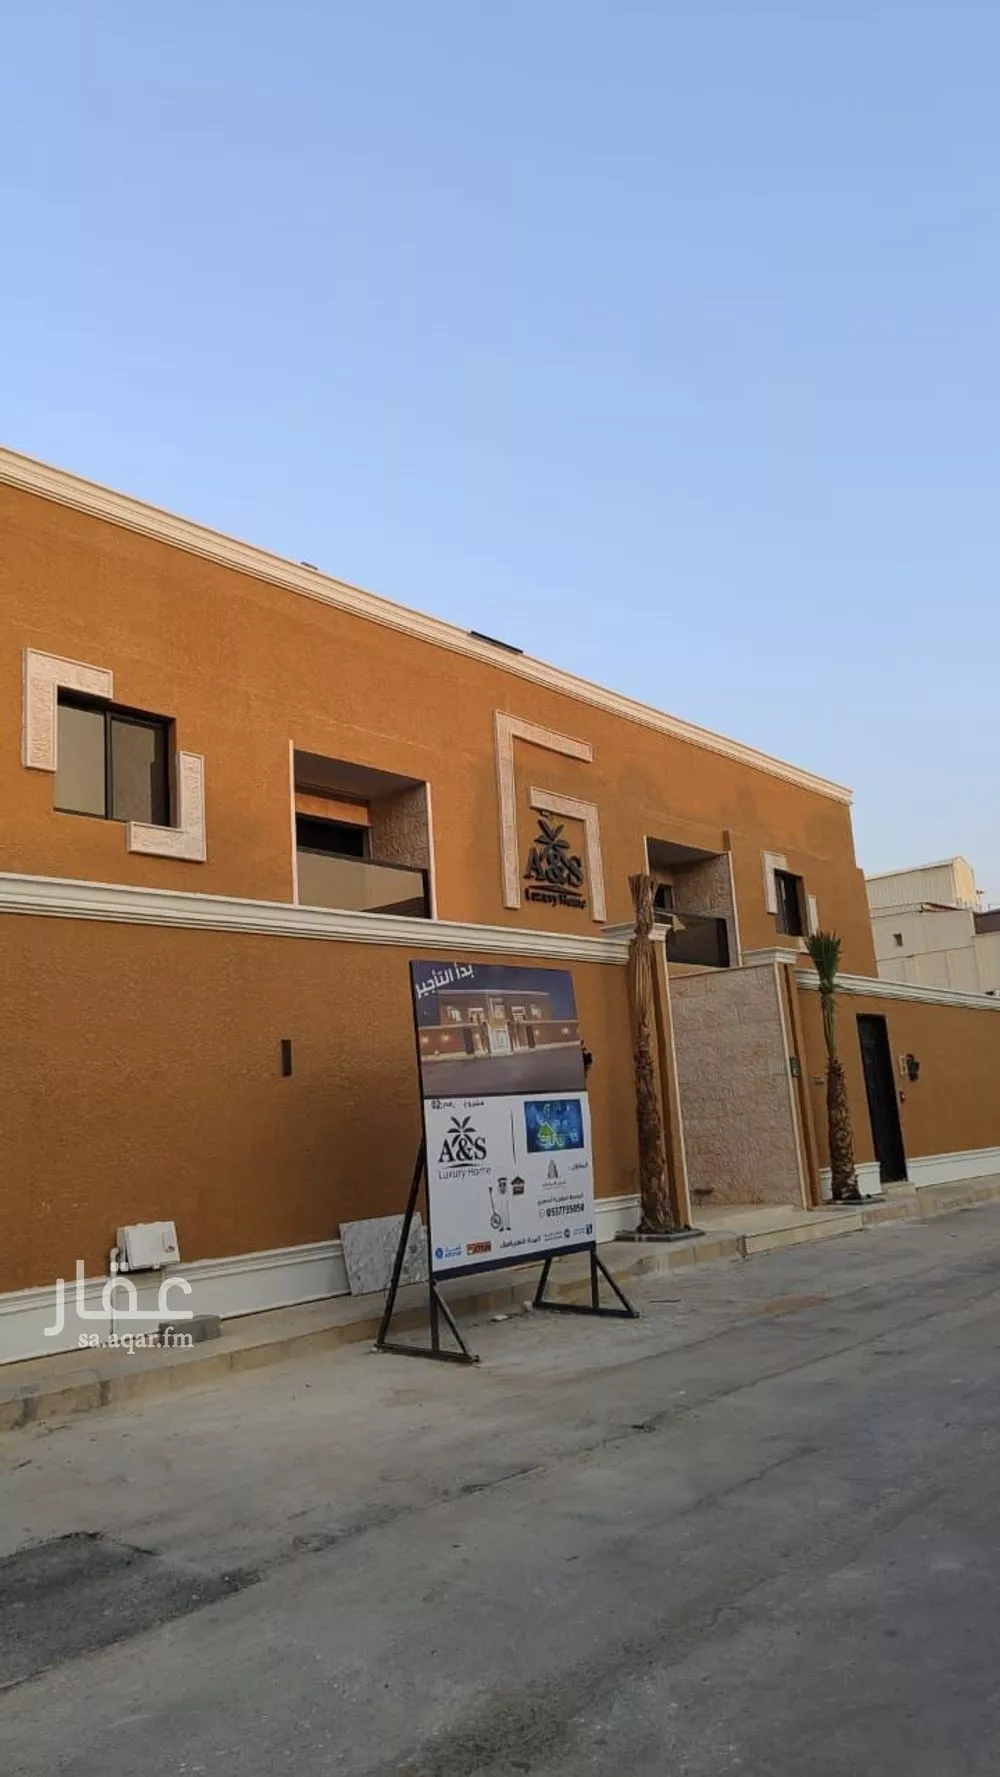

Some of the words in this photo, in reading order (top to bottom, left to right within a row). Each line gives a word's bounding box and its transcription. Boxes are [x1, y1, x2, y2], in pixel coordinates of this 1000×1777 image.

[523, 847, 584, 888] A&S
[415, 968, 454, 1000] التأجير
[454, 962, 475, 980] بدأ
[439, 1137, 487, 1163] A&S
[438, 1169, 466, 1180] Luxury
[467, 1166, 492, 1177] Home
